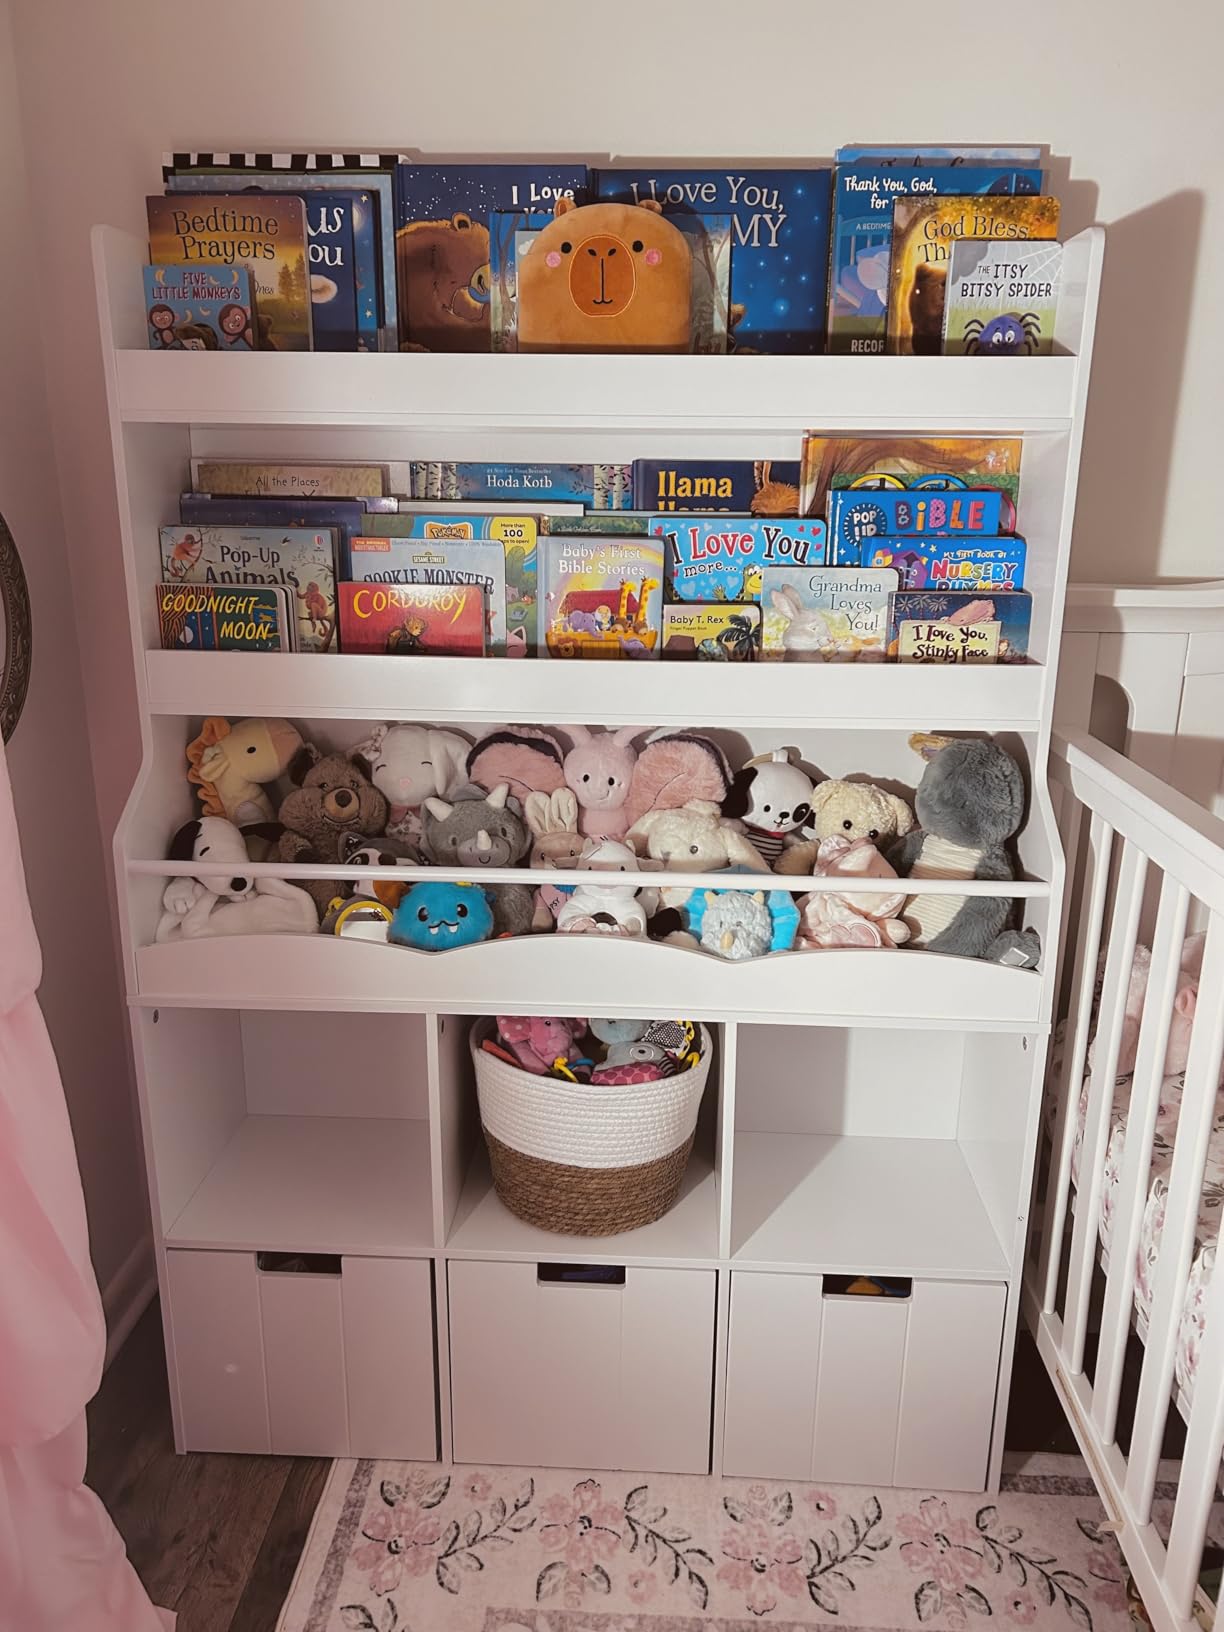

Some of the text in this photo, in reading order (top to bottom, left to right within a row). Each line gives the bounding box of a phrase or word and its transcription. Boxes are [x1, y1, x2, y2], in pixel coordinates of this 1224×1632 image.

[844, 175, 938, 194] Thank You, God,
[511, 183, 575, 205] I Love
[649, 179, 716, 204] Love
[727, 176, 784, 213] You,
[870, 194, 889, 209] for
[173, 207, 279, 236] Bedtime
[924, 216, 1029, 241] God Bless
[182, 236, 276, 264] Prayers
[183, 272, 206, 286] FIVE
[978, 264, 1028, 279] THE ITSY
[152, 287, 241, 300] LITTLE MONKEYS
[961, 283, 1052, 297] BITSY SPIDER
[255, 476, 320, 487] All the Places
[487, 474, 553, 488] Hoda Kotb
[657, 470, 733, 498] llama
[853, 511, 877, 525] POP
[503, 529, 523, 537] 100
[563, 544, 641, 559] Baby's First
[667, 526, 810, 564] I Love You
[220, 545, 280, 567] Pop-Up
[559, 559, 645, 575] Bible Stories
[684, 560, 737, 577] more...
[931, 559, 1018, 580] NURSERY
[206, 566, 299, 588] Animals
[809, 575, 882, 597] Grandma
[162, 594, 259, 614] GOODNIGHT
[353, 590, 467, 624] CORDUROY
[831, 595, 872, 614] Loves
[670, 616, 724, 625] Baby T. Rex
[847, 613, 879, 632] You!
[220, 622, 271, 640] MOON
[913, 625, 988, 643] I Love You,
[912, 644, 988, 662] Stinky Face
